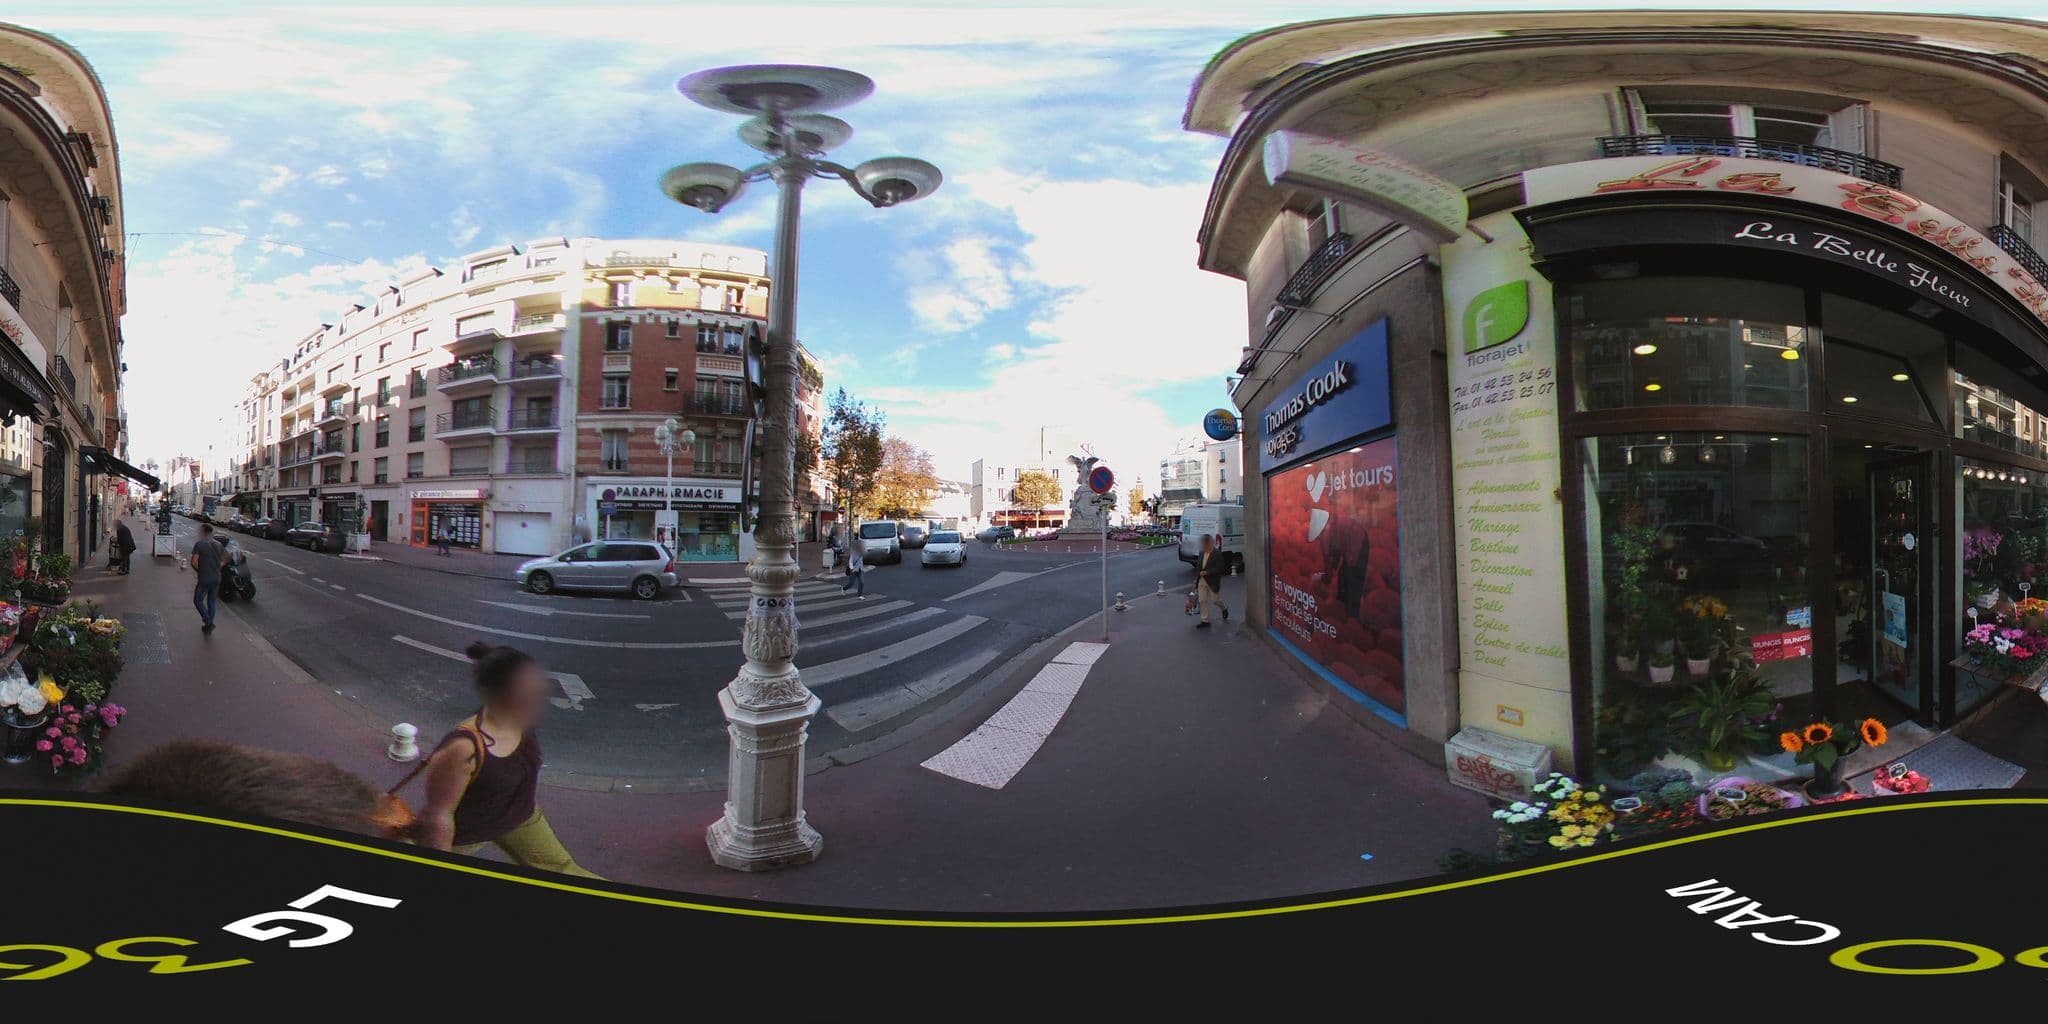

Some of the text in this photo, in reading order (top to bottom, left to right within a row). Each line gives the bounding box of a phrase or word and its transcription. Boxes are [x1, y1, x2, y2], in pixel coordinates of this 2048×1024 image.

[1734, 222, 1972, 308] La Belle Fleur
[1467, 344, 1524, 368] florajet
[1264, 360, 1348, 435] Thomas Cook
[1207, 415, 1236, 427] Thomas
[1265, 424, 1297, 458] voyages
[1328, 465, 1393, 497] jet tours
[616, 486, 724, 500] PARAPHARMACIE
[1467, 499, 1543, 514] Anniversaire
[1468, 518, 1521, 538] Mariage
[1471, 558, 1534, 577] Décoration
[1274, 575, 1318, 613] En voyage,
[1472, 579, 1515, 595] Accueil
[1473, 597, 1504, 613] Salle
[1280, 597, 1303, 618] monde
[1303, 610, 1313, 625] se
[1313, 615, 1337, 639] pare
[1282, 614, 1312, 642] couleurs
[1474, 632, 1567, 659] Centre de table
[1753, 638, 1782, 649] RUNGIS
[1783, 634, 1812, 645] RUNGIS
[1474, 649, 1507, 667] Deuil
